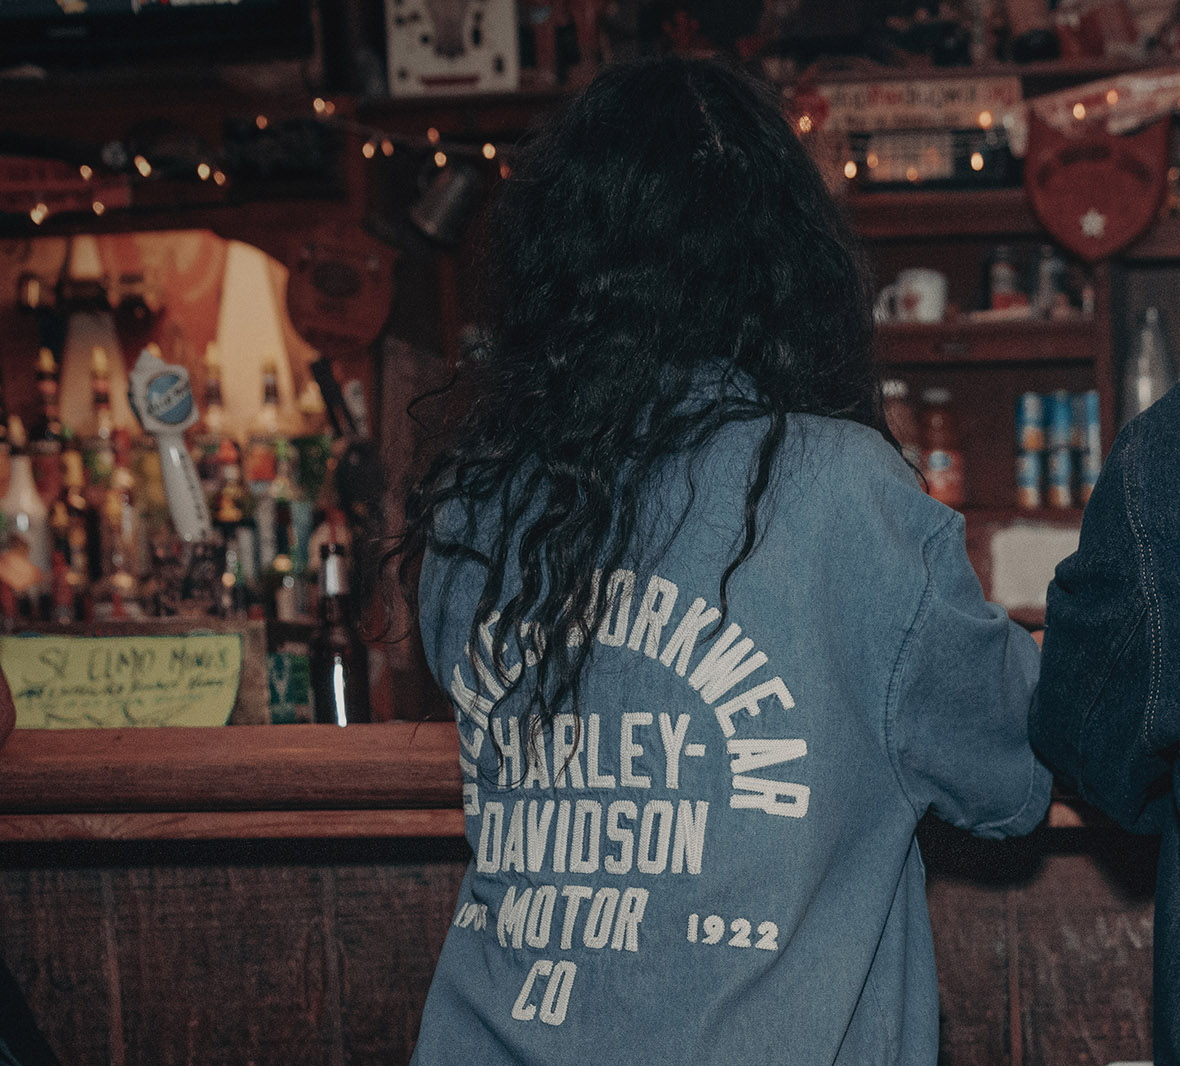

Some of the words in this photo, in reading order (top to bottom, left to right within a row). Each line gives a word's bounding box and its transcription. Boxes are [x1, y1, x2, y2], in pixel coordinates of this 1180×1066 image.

[492, 711, 706, 790] HARLEY-
[476, 799, 710, 876] DAVIDSON
[496, 885, 650, 952] MOTOR
[686, 914, 779, 951] 1922
[511, 960, 578, 1026] CO
